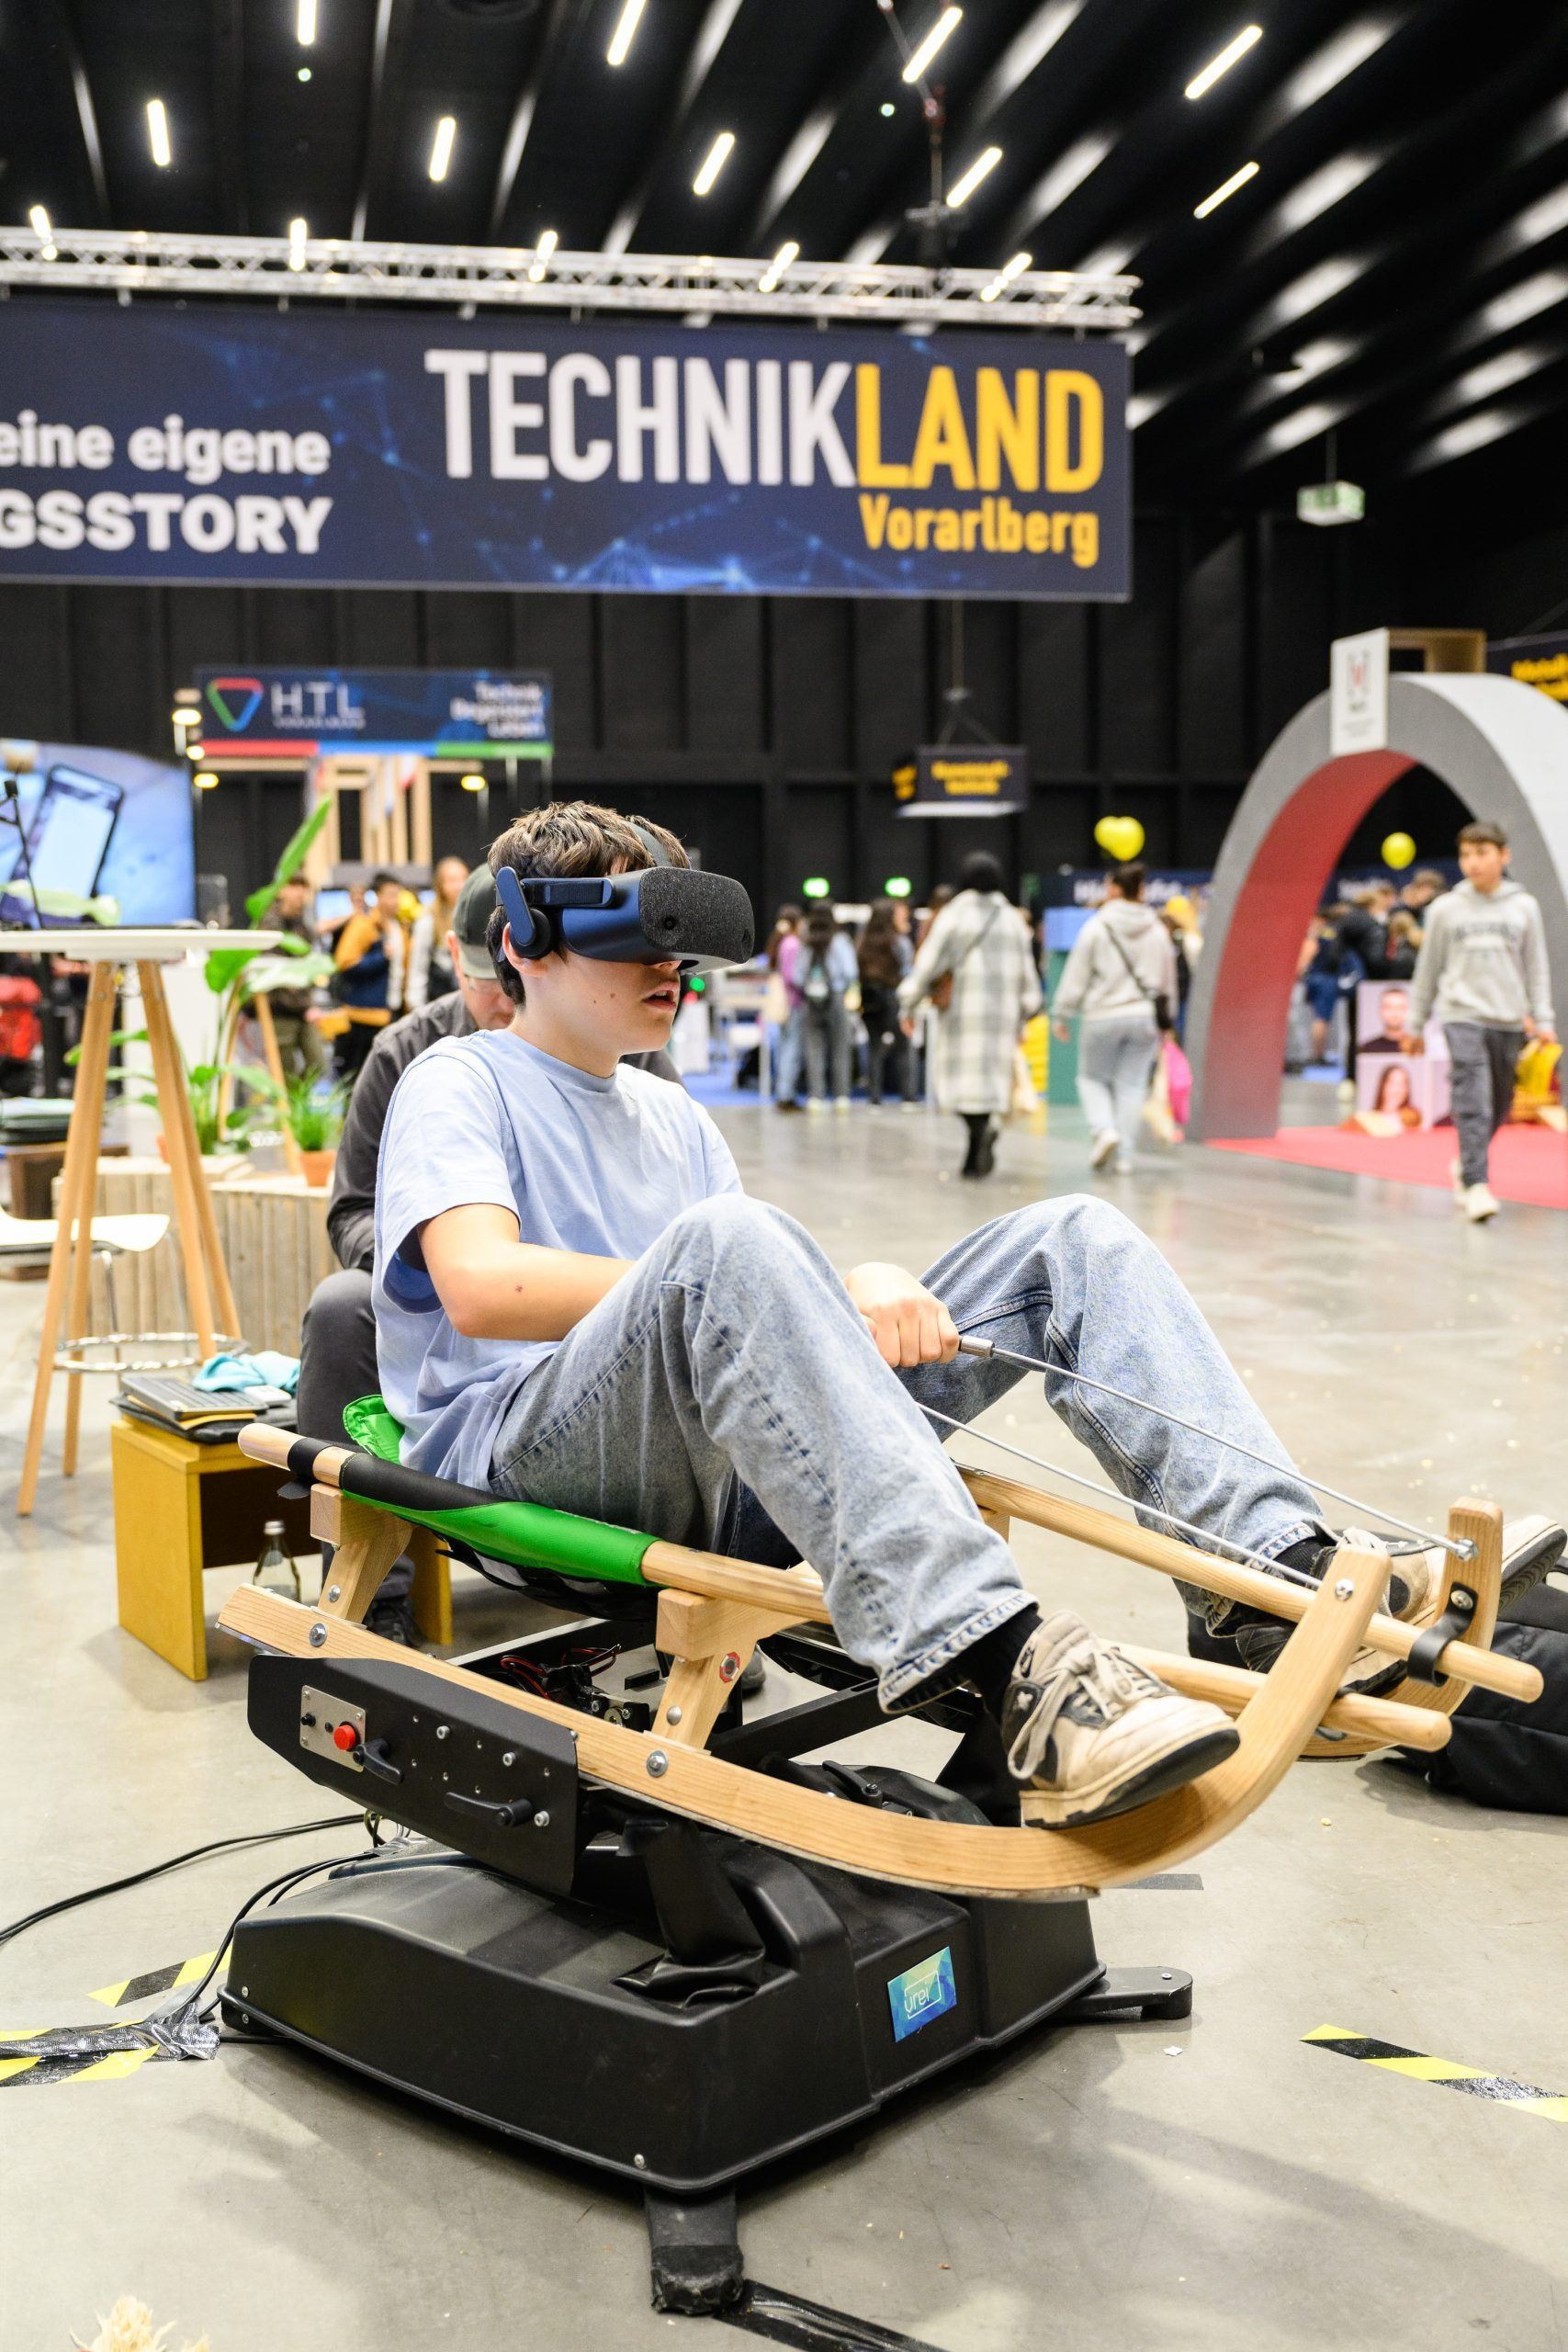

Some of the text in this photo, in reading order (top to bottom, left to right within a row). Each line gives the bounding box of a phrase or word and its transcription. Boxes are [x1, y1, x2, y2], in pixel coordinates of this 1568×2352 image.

[128, 413, 331, 485] eigene
[424, 349, 1103, 493] TECHNIKLAND
[0, 489, 333, 554] GSSTORY
[858, 493, 1100, 568] Vorarlberg
[271, 682, 364, 719] HTL
